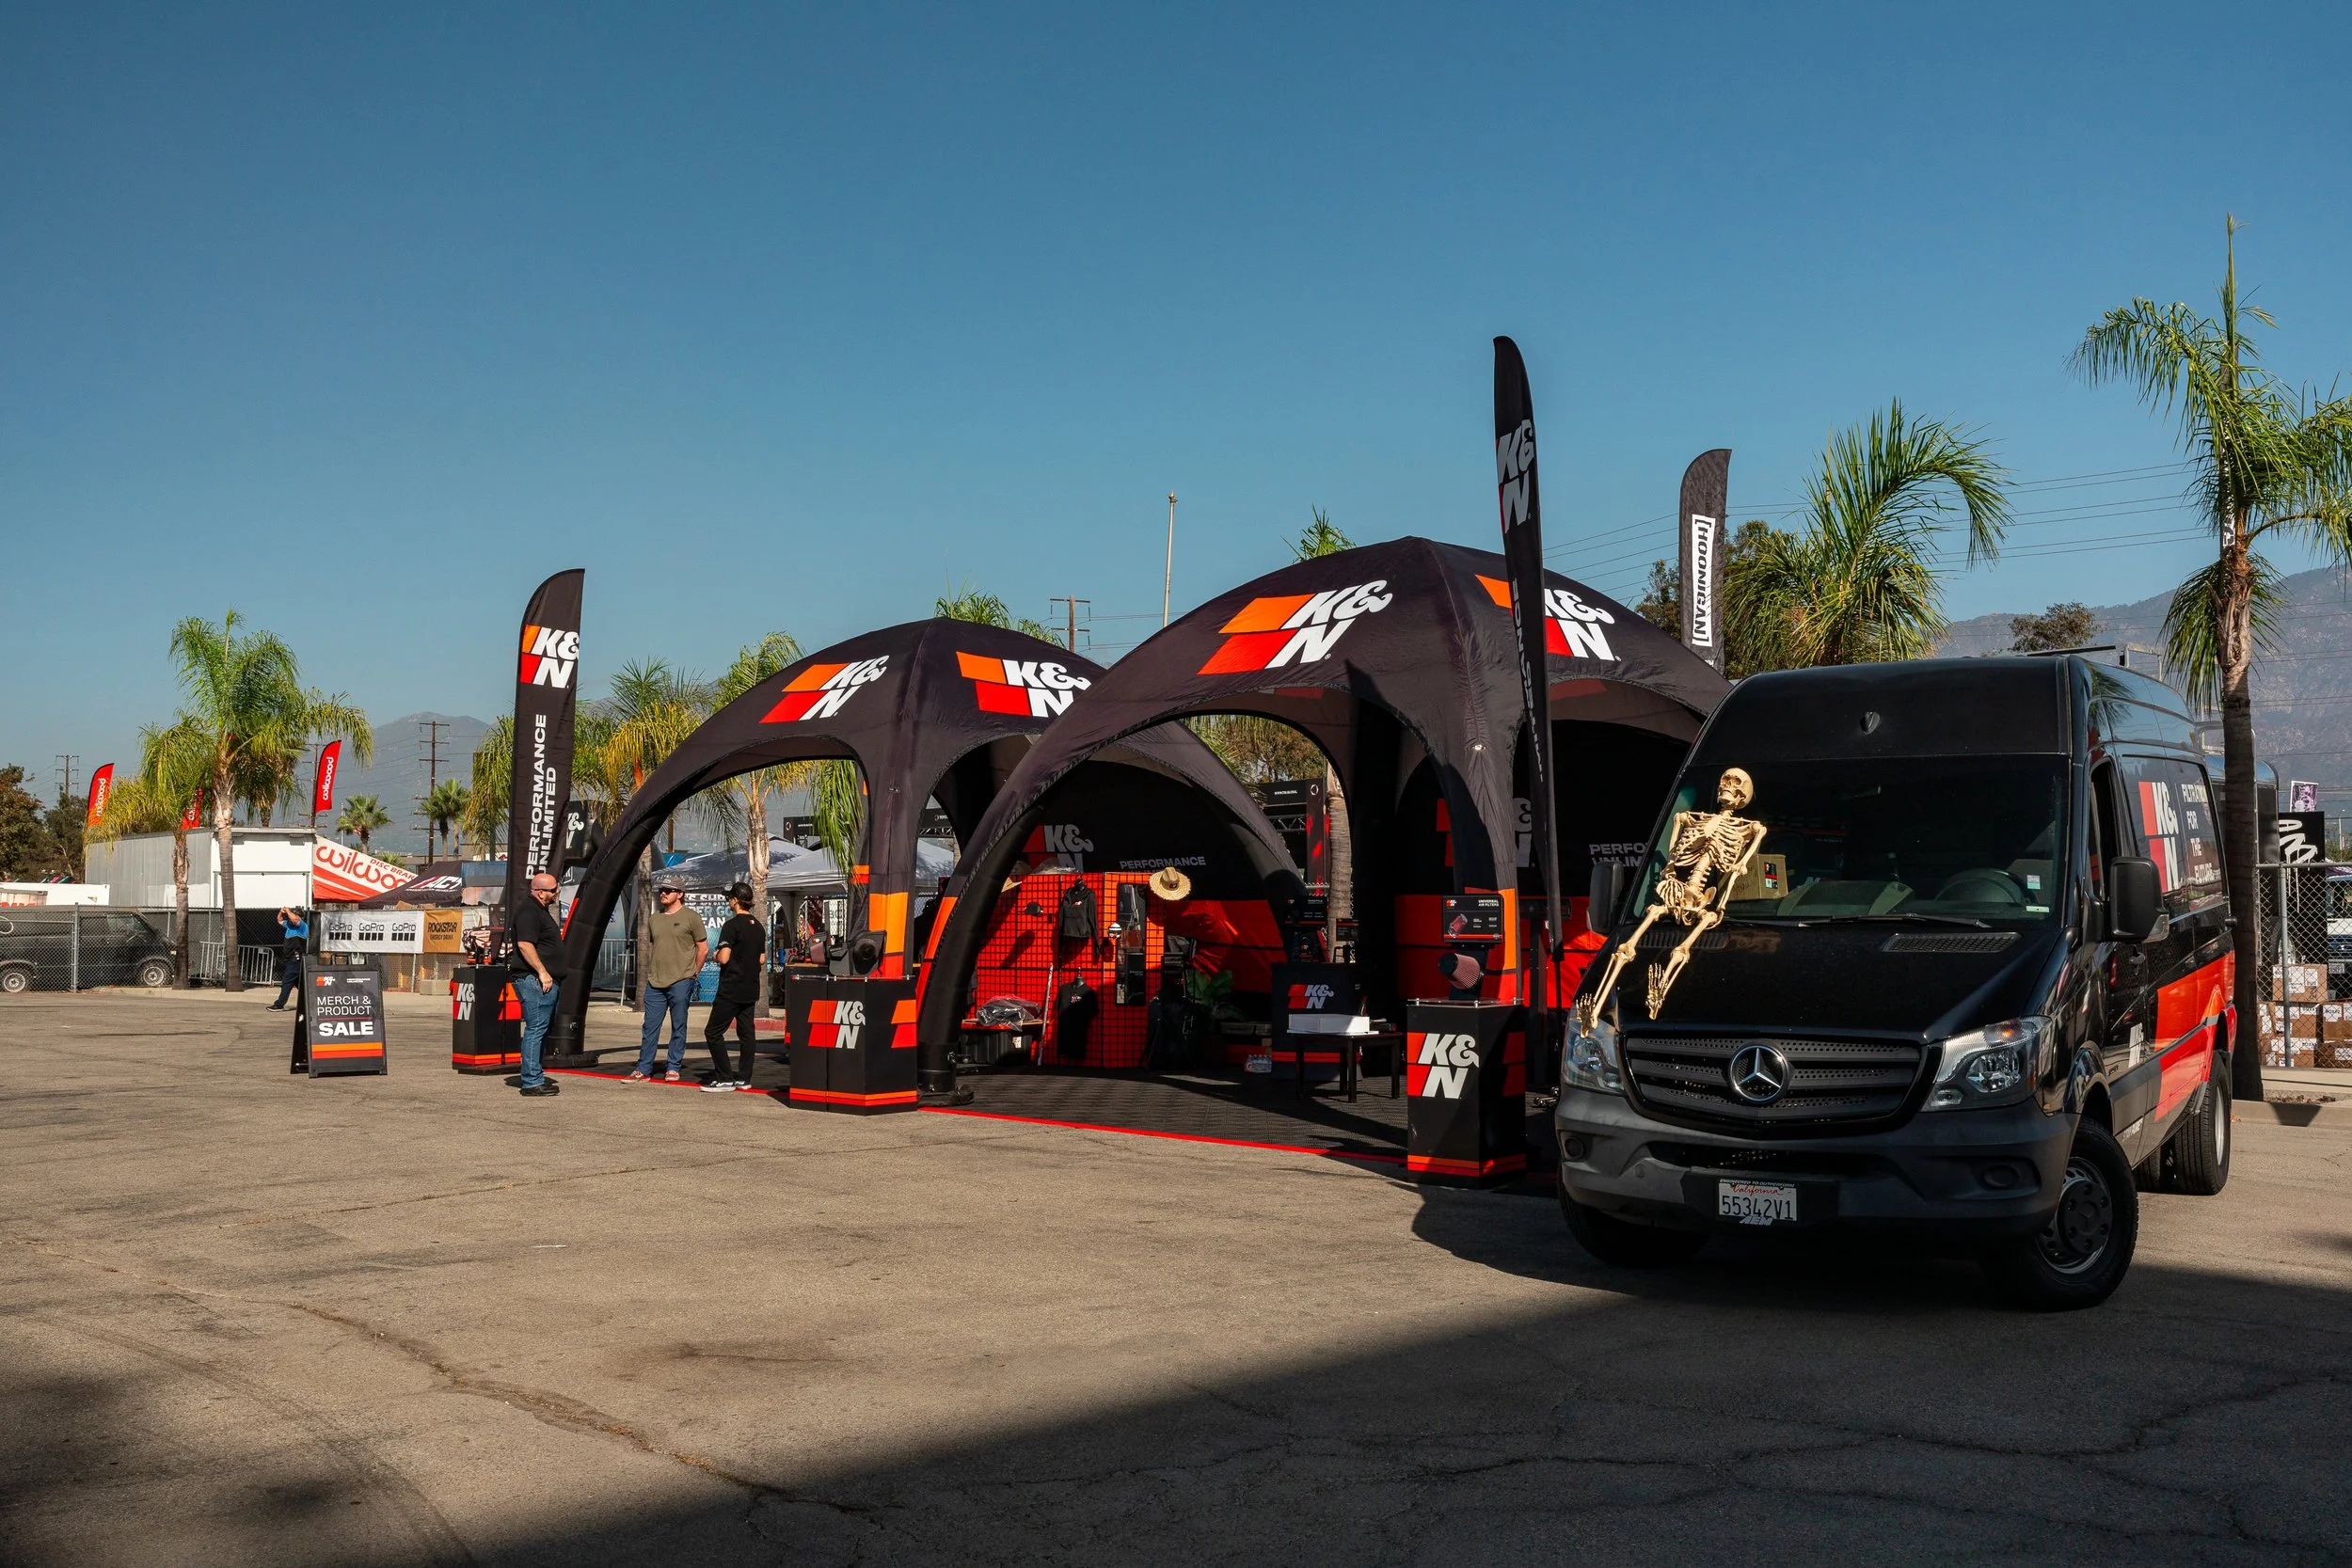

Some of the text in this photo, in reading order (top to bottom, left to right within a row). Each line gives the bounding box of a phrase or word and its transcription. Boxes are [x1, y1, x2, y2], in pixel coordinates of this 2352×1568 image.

[323, 756, 334, 800] wilwood
[526, 714, 547, 879] PERFORMANCE
[2186, 811, 2199, 830] FOR
[1588, 843, 1648, 855] PERFO
[2190, 837, 2201, 857] THE
[370, 858, 389, 871] DISC
[1120, 856, 1206, 869] PERFORMANCE
[329, 923, 416, 931] GoPro GoPro GoPro
[427, 922, 457, 933] ROCKSTAR
[317, 995, 371, 1006] MERCH &
[317, 1006, 372, 1016] PRODUCT
[319, 1021, 373, 1037] SALE
[1732, 1183, 1783, 1196] California
[1722, 1196, 1793, 1220] 55342V1
[1739, 1215, 1774, 1226] AEM
